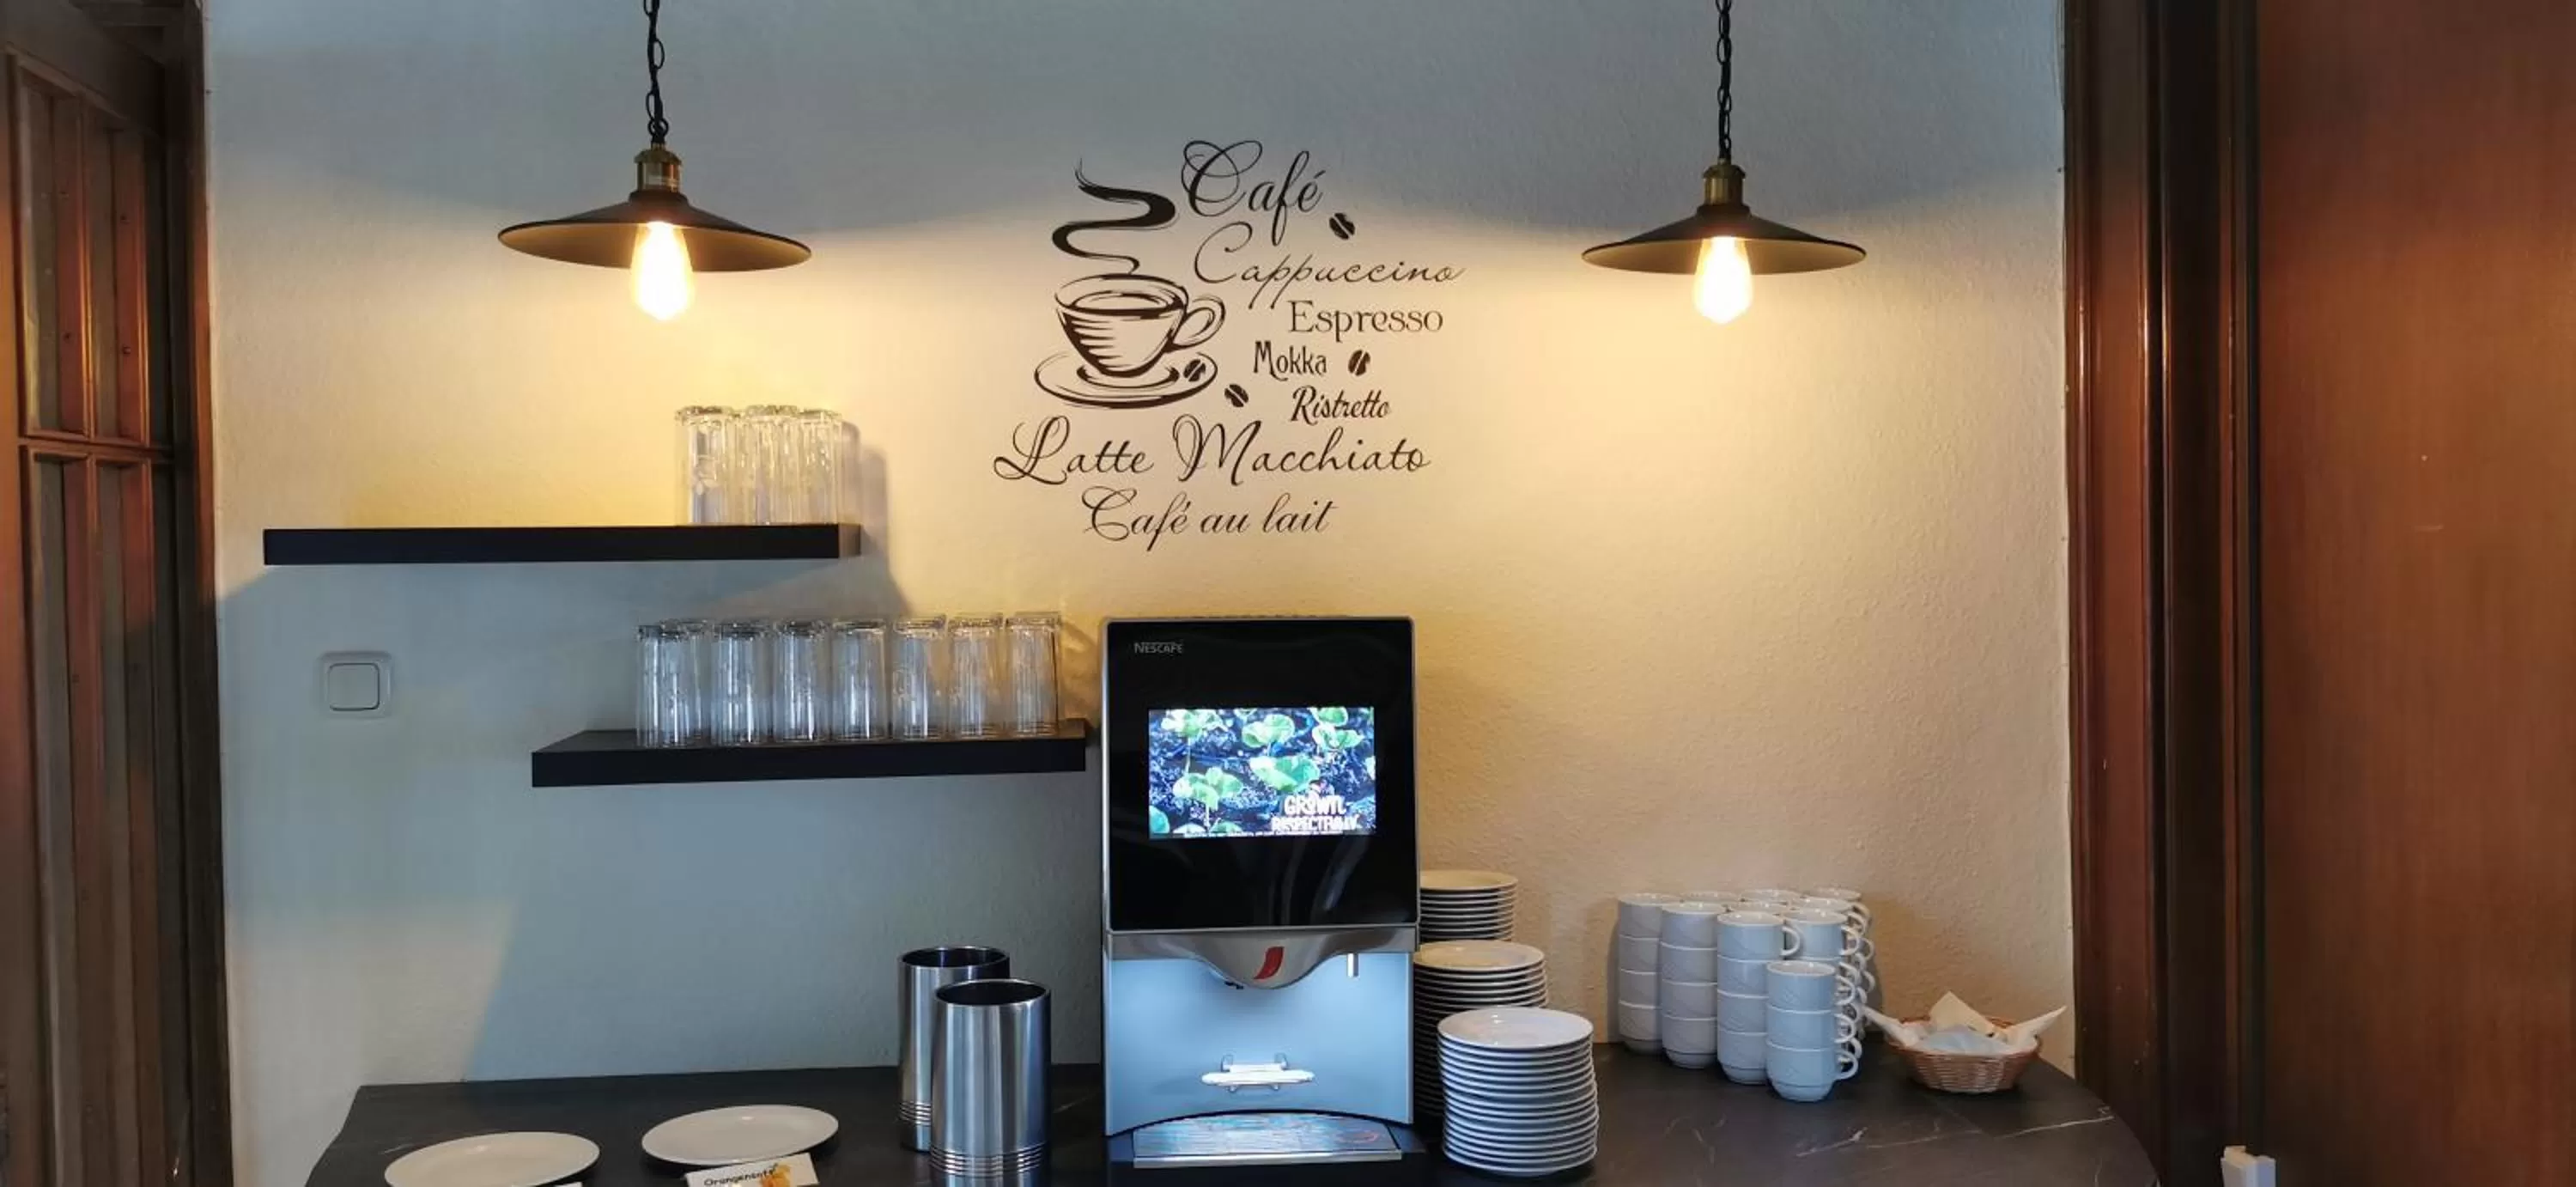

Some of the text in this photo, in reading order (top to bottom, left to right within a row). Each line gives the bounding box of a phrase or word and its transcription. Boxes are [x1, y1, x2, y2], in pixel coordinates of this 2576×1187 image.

[1182, 140, 1326, 246] Café
[1194, 222, 1465, 309] Cappuccino
[1288, 301, 1443, 342] Espresso
[1253, 341, 1327, 380] Mokka
[1290, 386, 1390, 424] Ristretto
[993, 414, 1432, 486] Latte Macchiato
[1081, 485, 1337, 551] Café au lait
